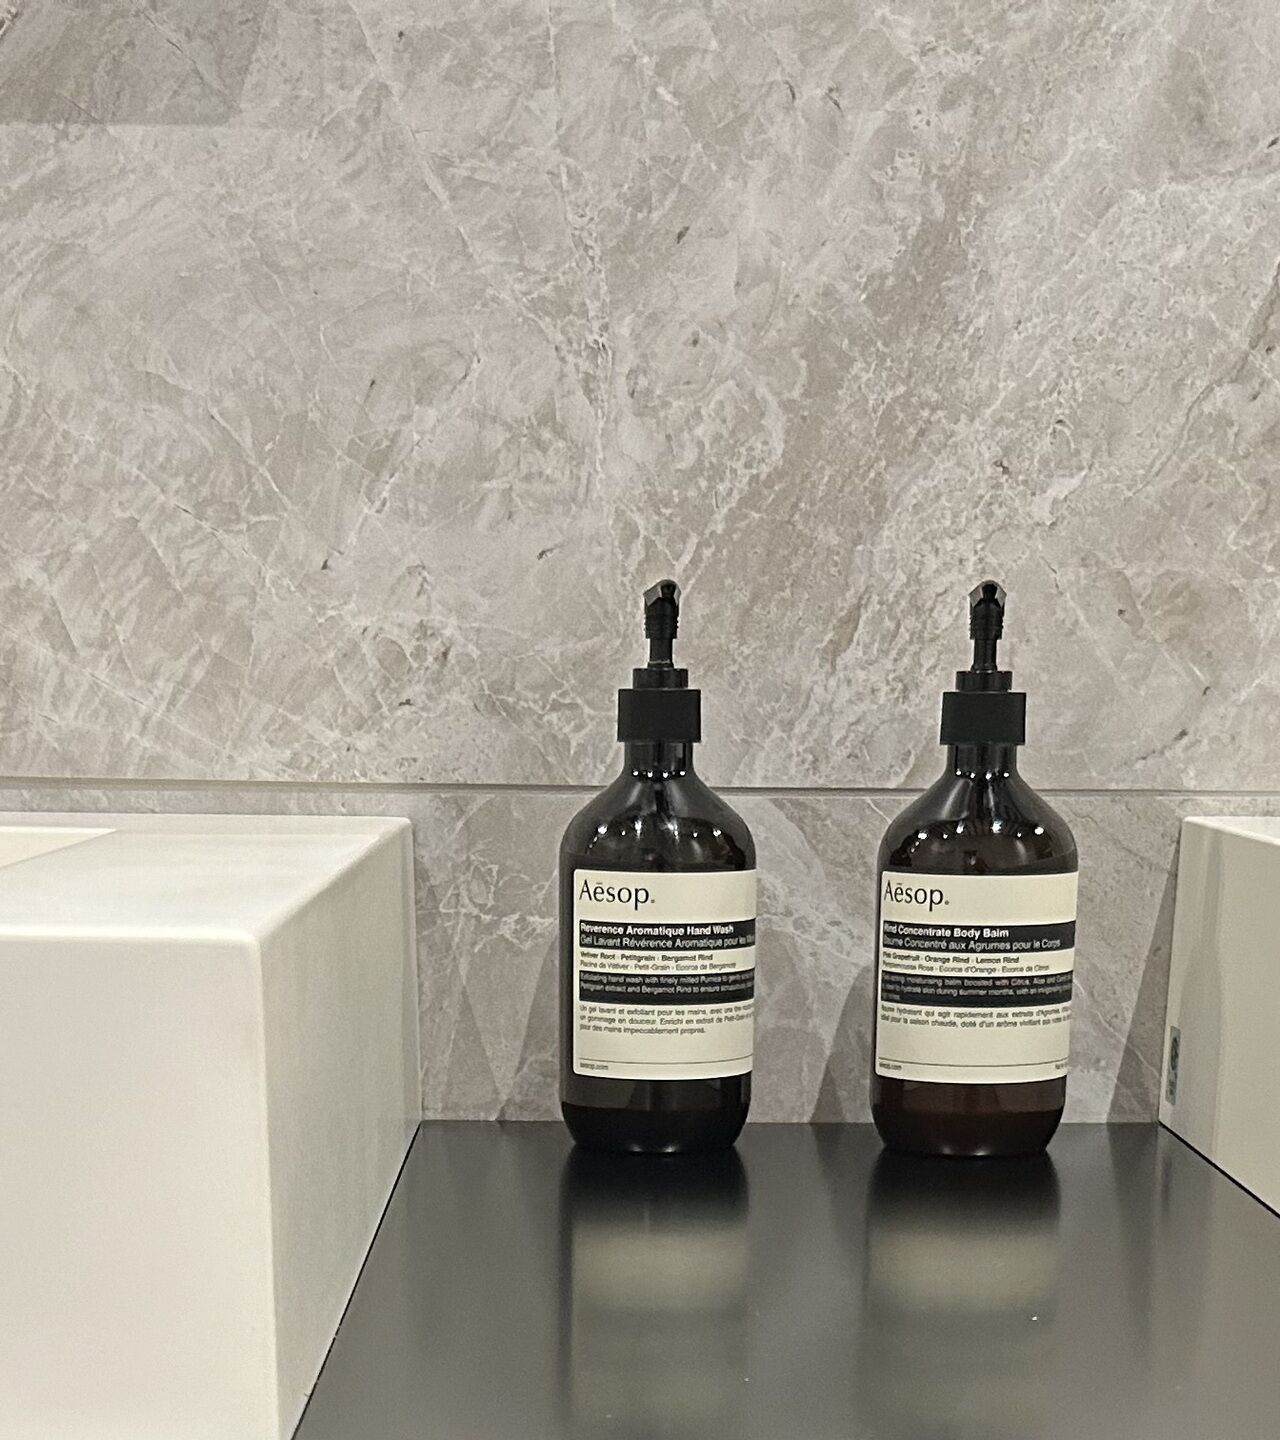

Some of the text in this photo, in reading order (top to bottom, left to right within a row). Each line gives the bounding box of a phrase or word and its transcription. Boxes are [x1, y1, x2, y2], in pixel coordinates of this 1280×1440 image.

[581, 923, 734, 937] Reverence Aromatique Hand Wash
[898, 925, 951, 937] Concentrate
[954, 928, 981, 940] Body
[983, 928, 1009, 938] Balm
[581, 935, 592, 944] Gel
[594, 936, 620, 946] Lavant
[623, 938, 672, 947] Révérence
[675, 938, 722, 949] Aromatique
[724, 938, 738, 947] pour
[904, 938, 947, 948] Concentré
[969, 941, 1010, 952] Agrumes
[1012, 942, 1032, 950] pour
[1033, 940, 1040, 948] le
[1042, 939, 1060, 948] Corps
[925, 955, 950, 964] Orange
